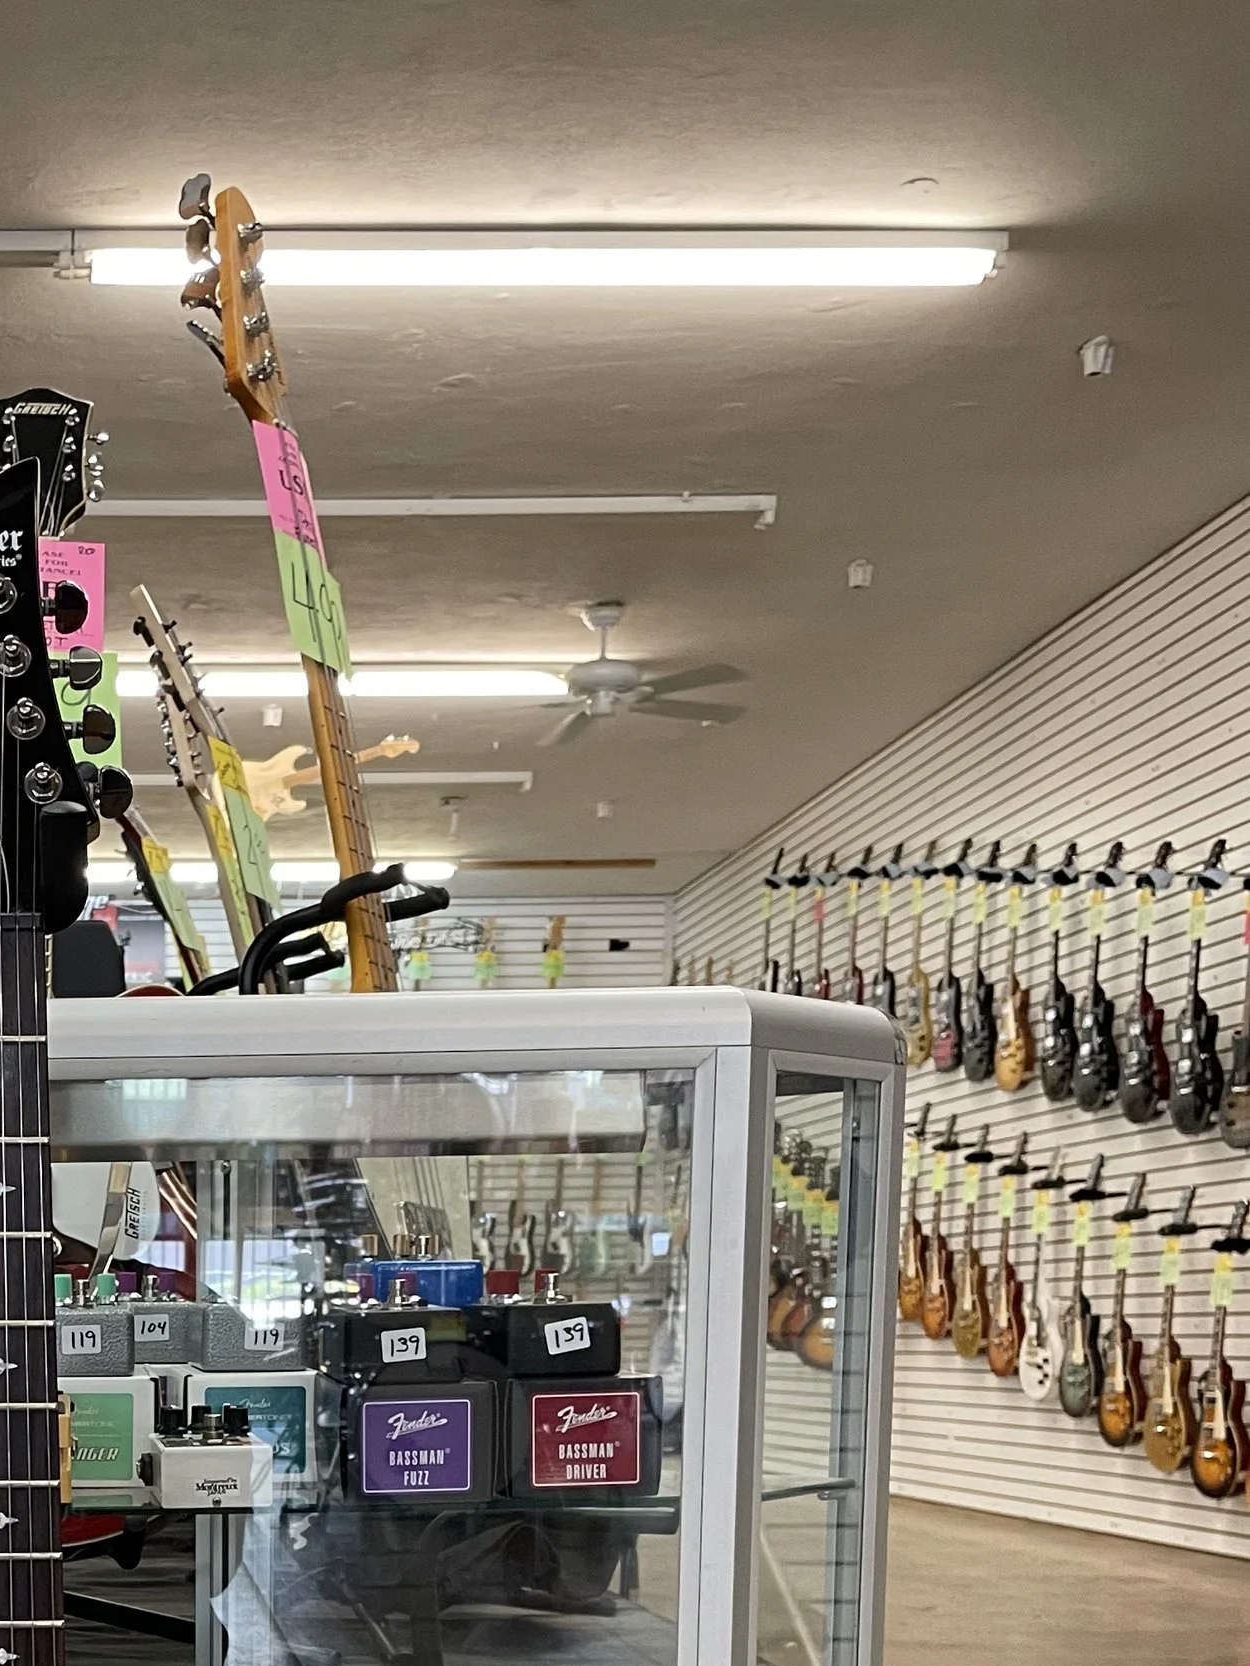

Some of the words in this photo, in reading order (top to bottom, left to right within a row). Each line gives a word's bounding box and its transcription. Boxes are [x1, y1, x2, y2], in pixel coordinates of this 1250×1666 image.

[40, 567, 81, 576] TANCE!
[124, 1187, 141, 1240] GRETSCH
[140, 1320, 167, 1335] 104
[555, 1323, 585, 1348] 139
[71, 1330, 96, 1349] 119
[254, 1328, 280, 1346] 119
[390, 1335, 420, 1357] 139
[386, 1411, 448, 1440] Fender
[555, 1403, 618, 1433] Fender
[389, 1450, 444, 1467] BASSMAN
[559, 1443, 614, 1459] BASSMAN
[403, 1471, 429, 1487] FUZZ
[566, 1464, 607, 1480] DRIVER
